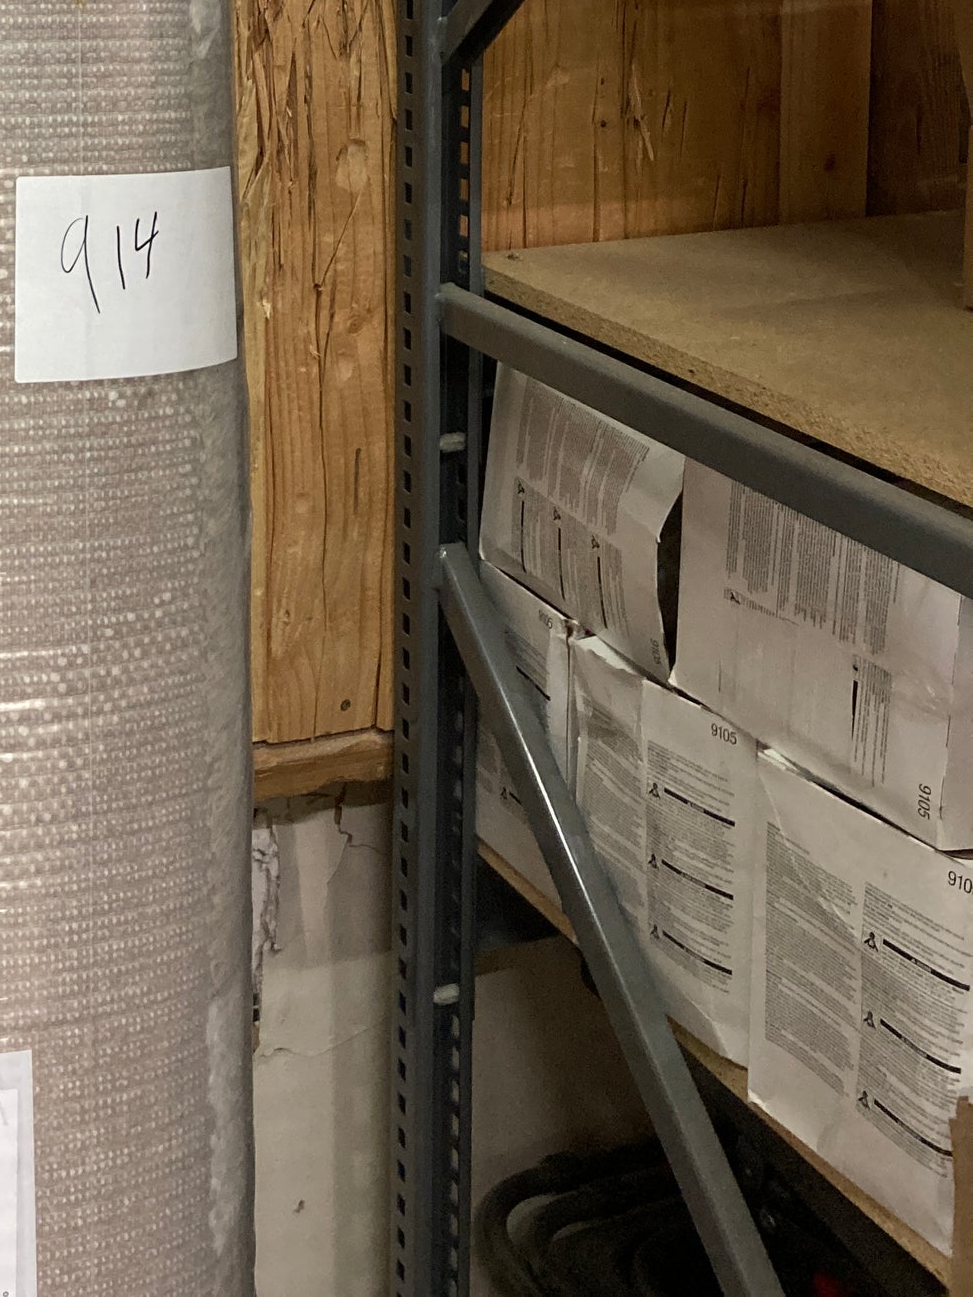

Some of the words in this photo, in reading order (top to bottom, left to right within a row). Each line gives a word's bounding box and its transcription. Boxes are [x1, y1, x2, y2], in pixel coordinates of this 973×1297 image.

[60, 210, 160, 315] 914
[711, 722, 737, 745] 9105
[917, 783, 932, 820] 9105
[947, 870, 973, 894] 910
